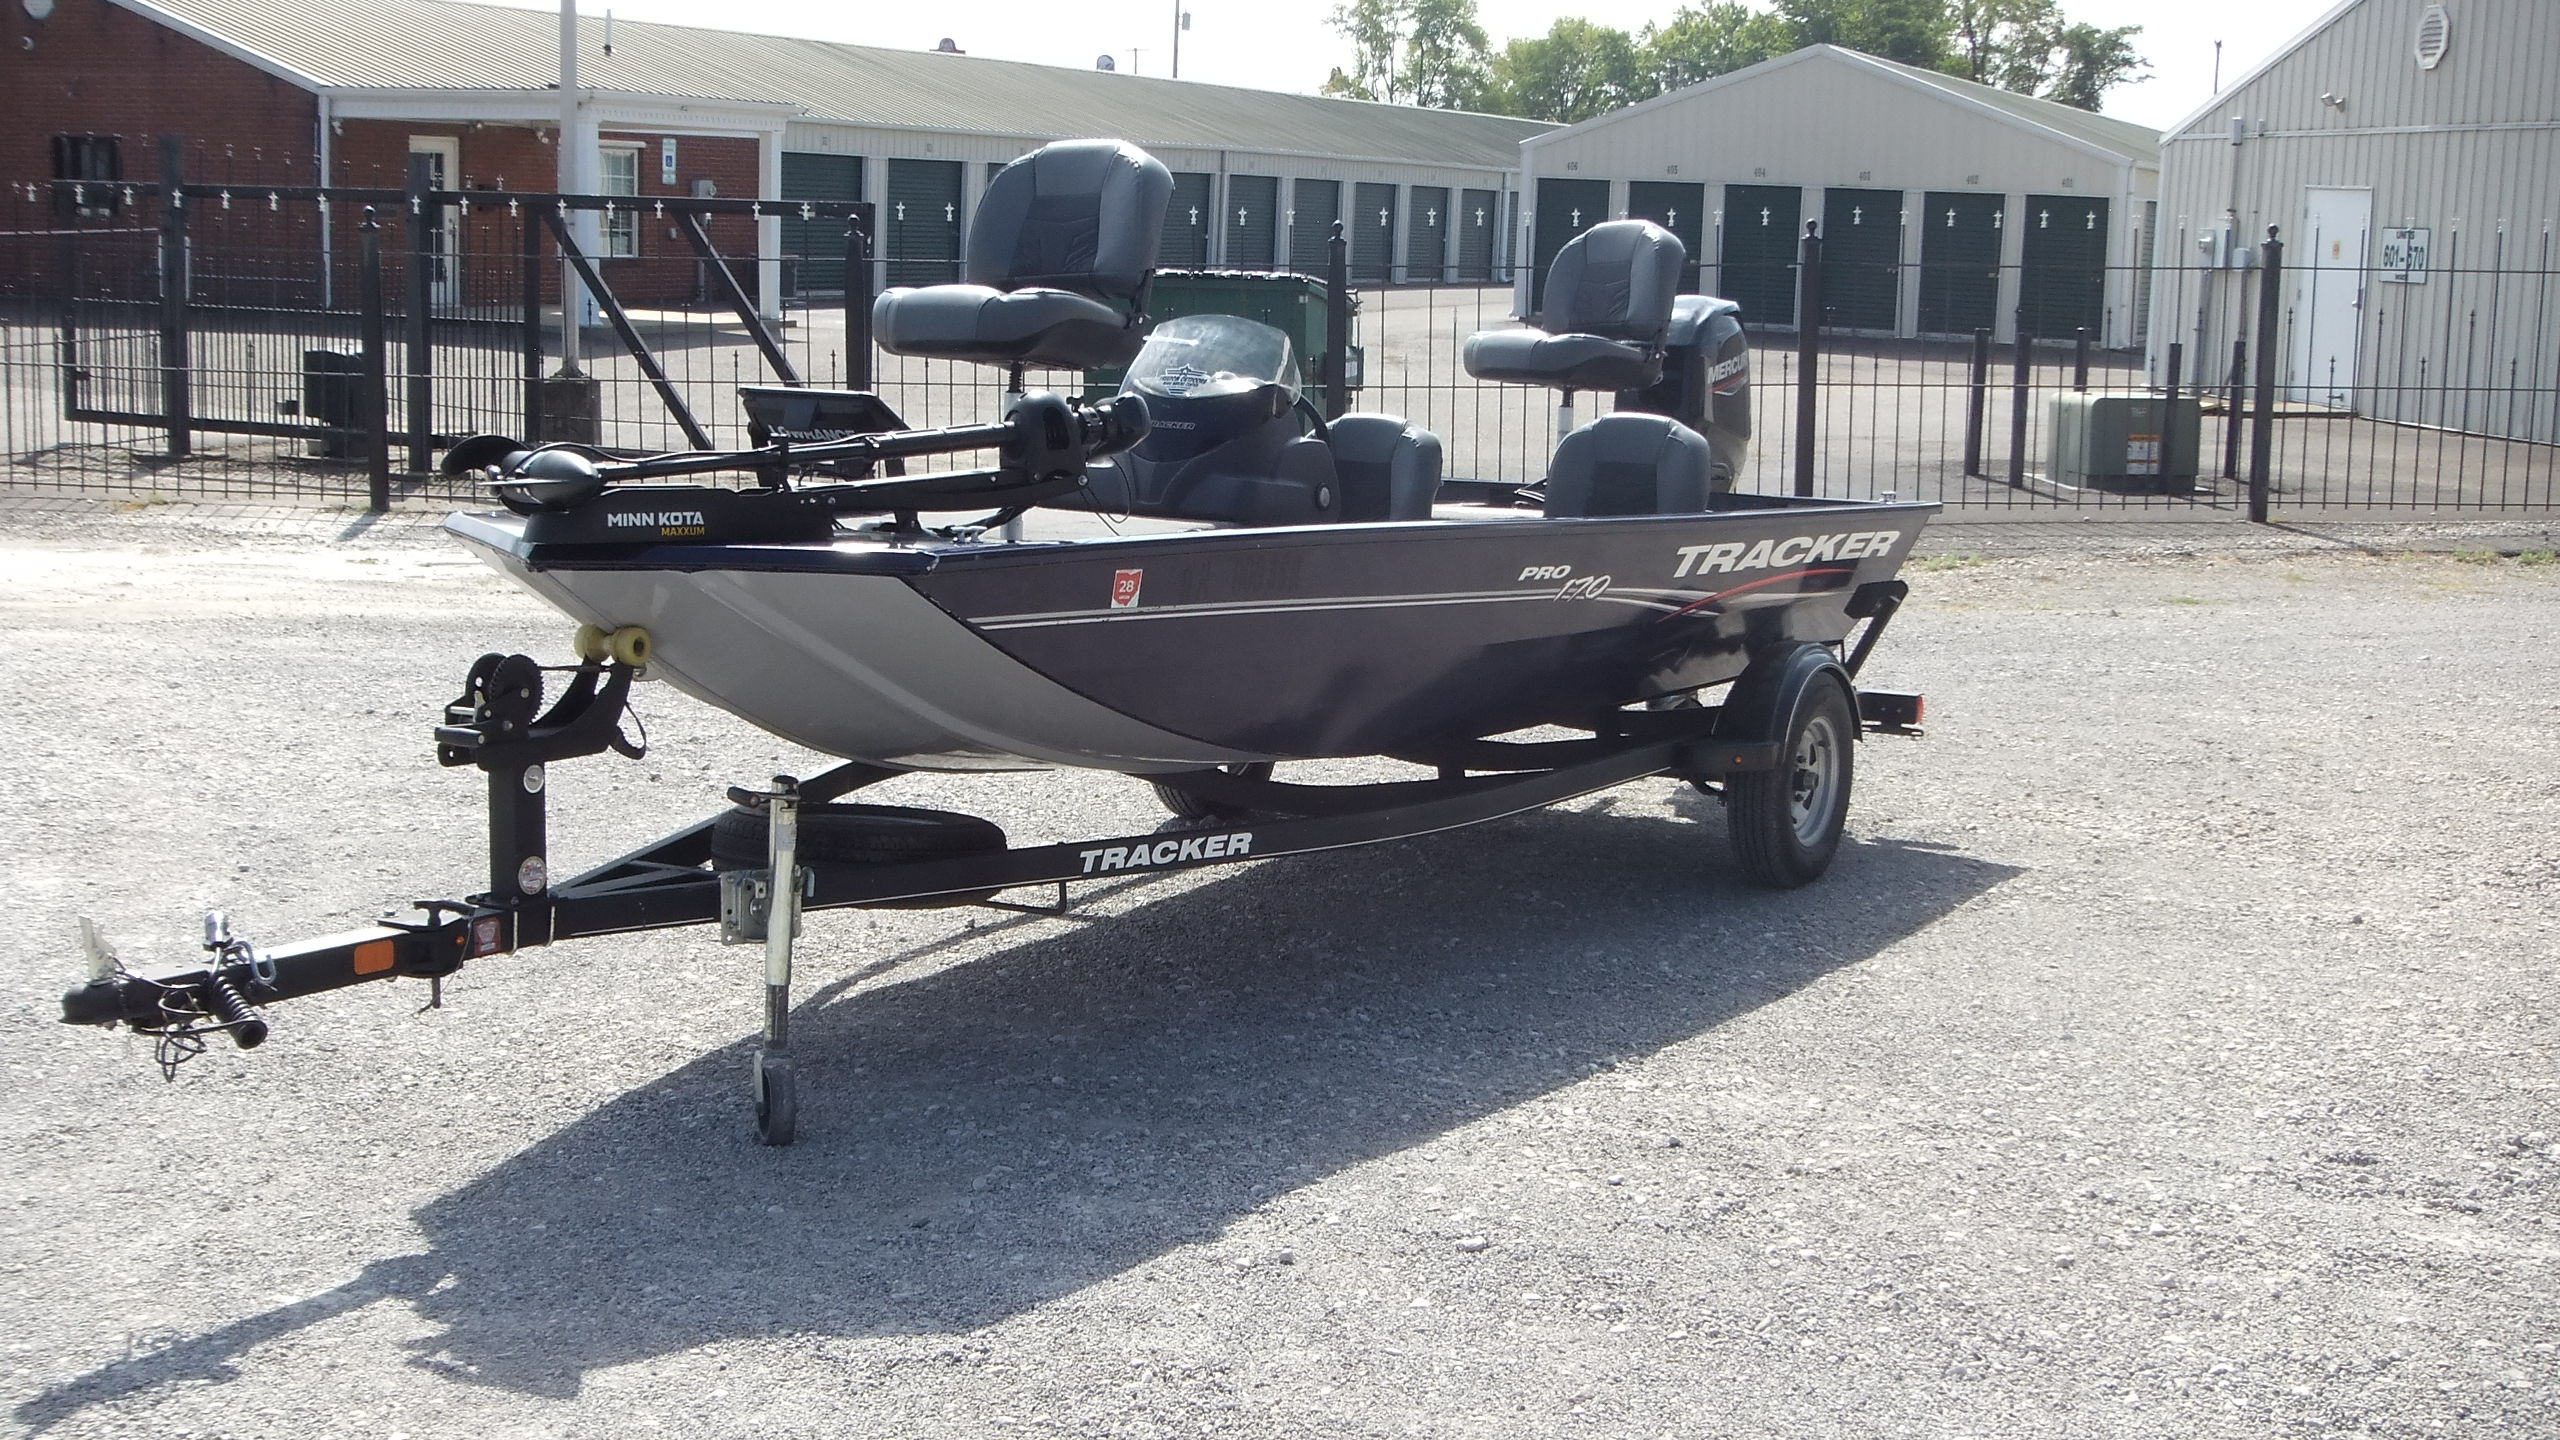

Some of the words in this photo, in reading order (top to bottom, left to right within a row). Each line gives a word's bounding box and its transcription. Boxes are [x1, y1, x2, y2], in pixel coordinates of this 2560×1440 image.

[2383, 245, 2424, 269] 601-670
[1151, 420, 1196, 430] RACKER
[607, 512, 655, 528] MINN
[658, 511, 705, 526] KOTA
[661, 526, 705, 537] MAXXUM
[1672, 530, 1901, 579] TRACKER
[1518, 564, 1572, 582] PRO
[1118, 579, 1135, 593] 28
[1552, 574, 1612, 602] 170
[1079, 832, 1253, 874] TRACKER
